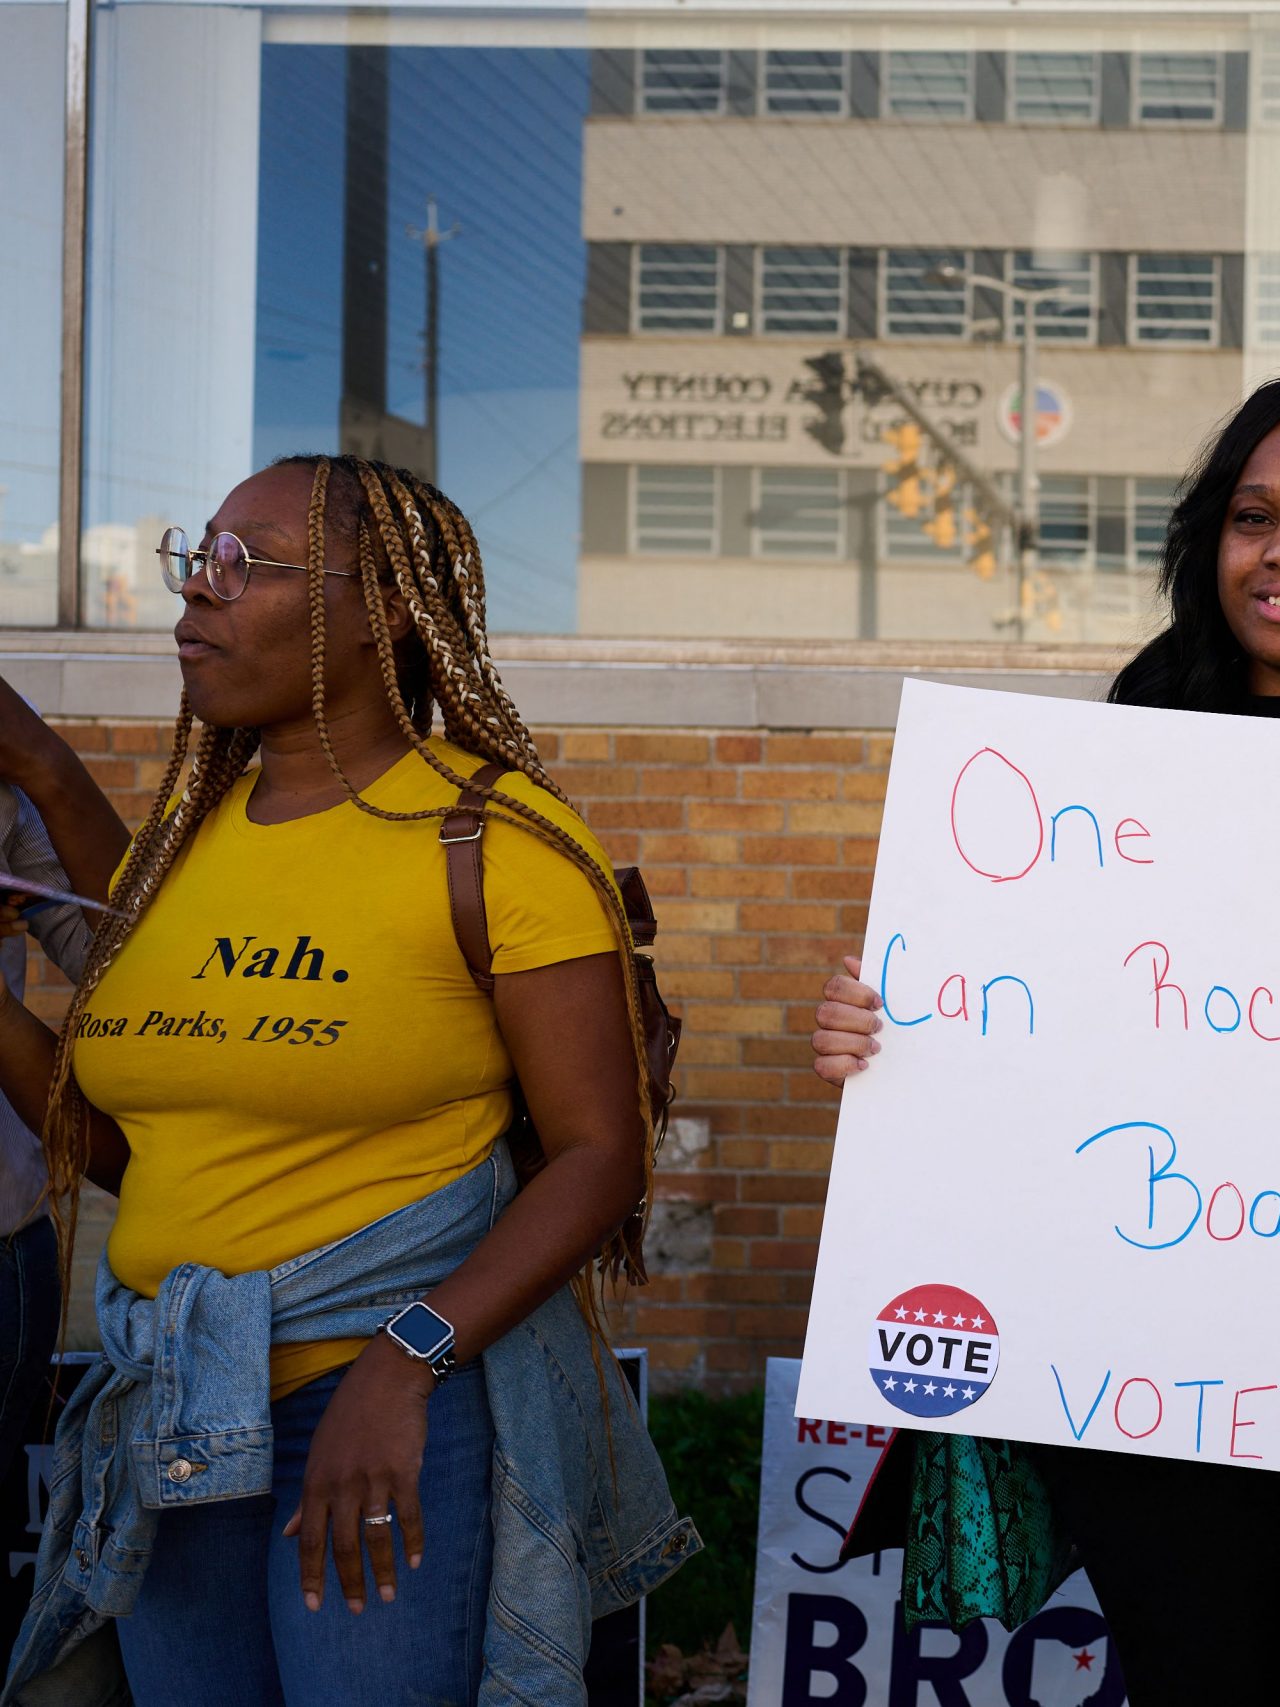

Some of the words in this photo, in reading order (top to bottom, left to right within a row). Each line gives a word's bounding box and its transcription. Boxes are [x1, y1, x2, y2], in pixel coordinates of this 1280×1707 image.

[951, 746, 1154, 882] One
[191, 936, 349, 983] Nah.
[881, 933, 1034, 1036] Can
[75, 1012, 128, 1038] Rosa
[134, 1010, 227, 1044] Parks,
[242, 1014, 348, 1047] 1955
[877, 1328, 992, 1374] VOTE
[798, 1417, 886, 1447] RE-E
[1051, 1364, 1277, 1459] VOTE
[781, 1593, 1130, 1707] BRO
